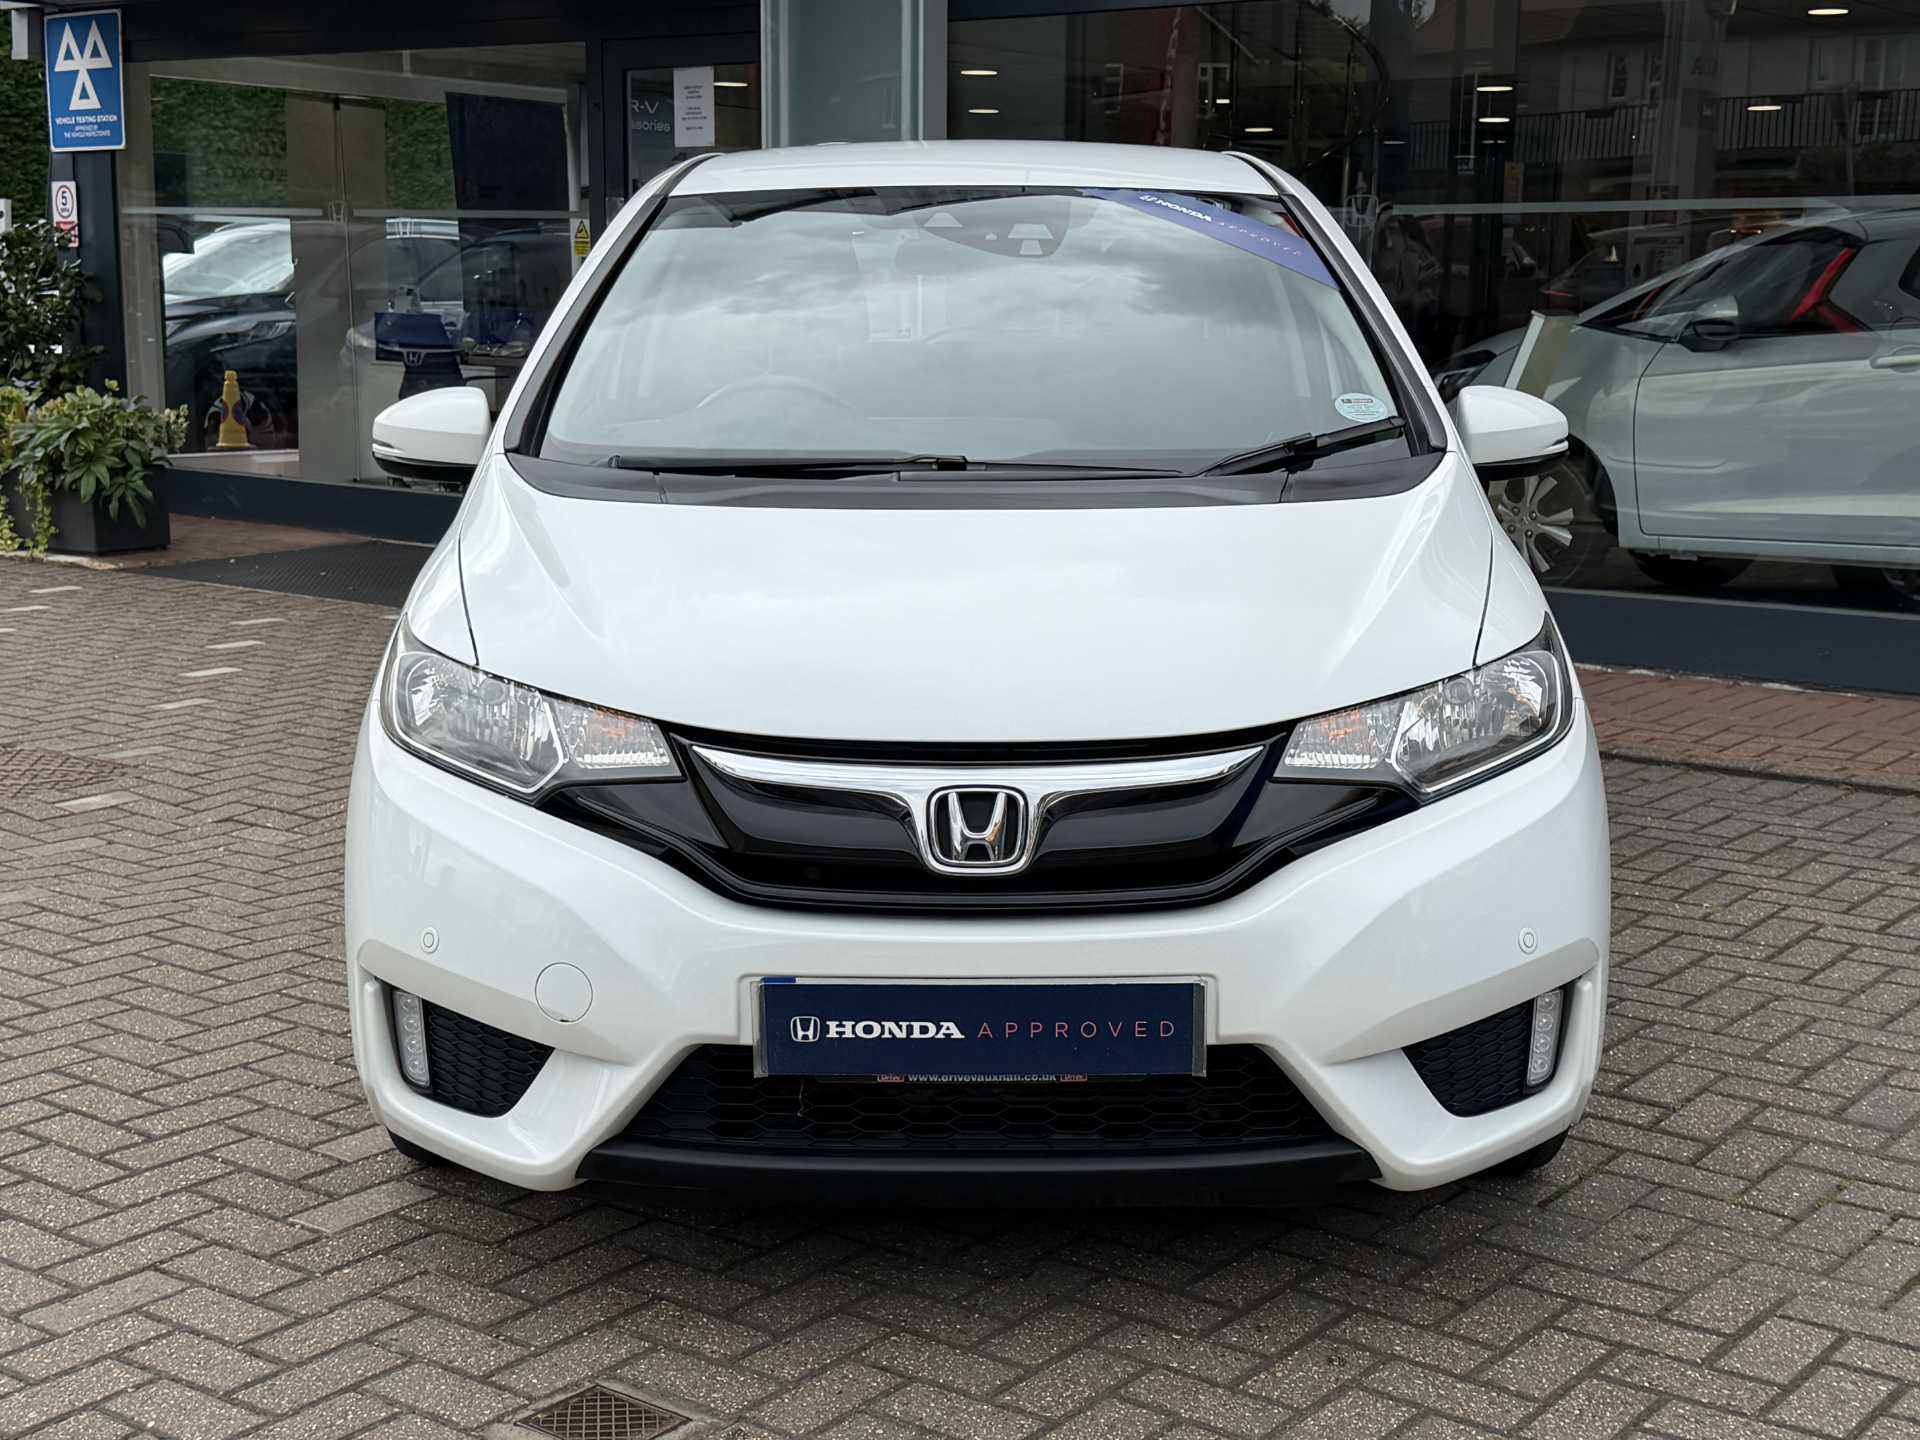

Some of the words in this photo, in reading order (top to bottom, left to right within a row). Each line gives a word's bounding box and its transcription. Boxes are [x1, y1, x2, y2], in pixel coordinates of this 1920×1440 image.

[76, 116, 97, 124] TESTING
[61, 191, 67, 206] 5
[1156, 199, 1212, 222] HONDA
[826, 1020, 966, 1039] HONDA
[977, 1021, 1175, 1039] APPROVED
